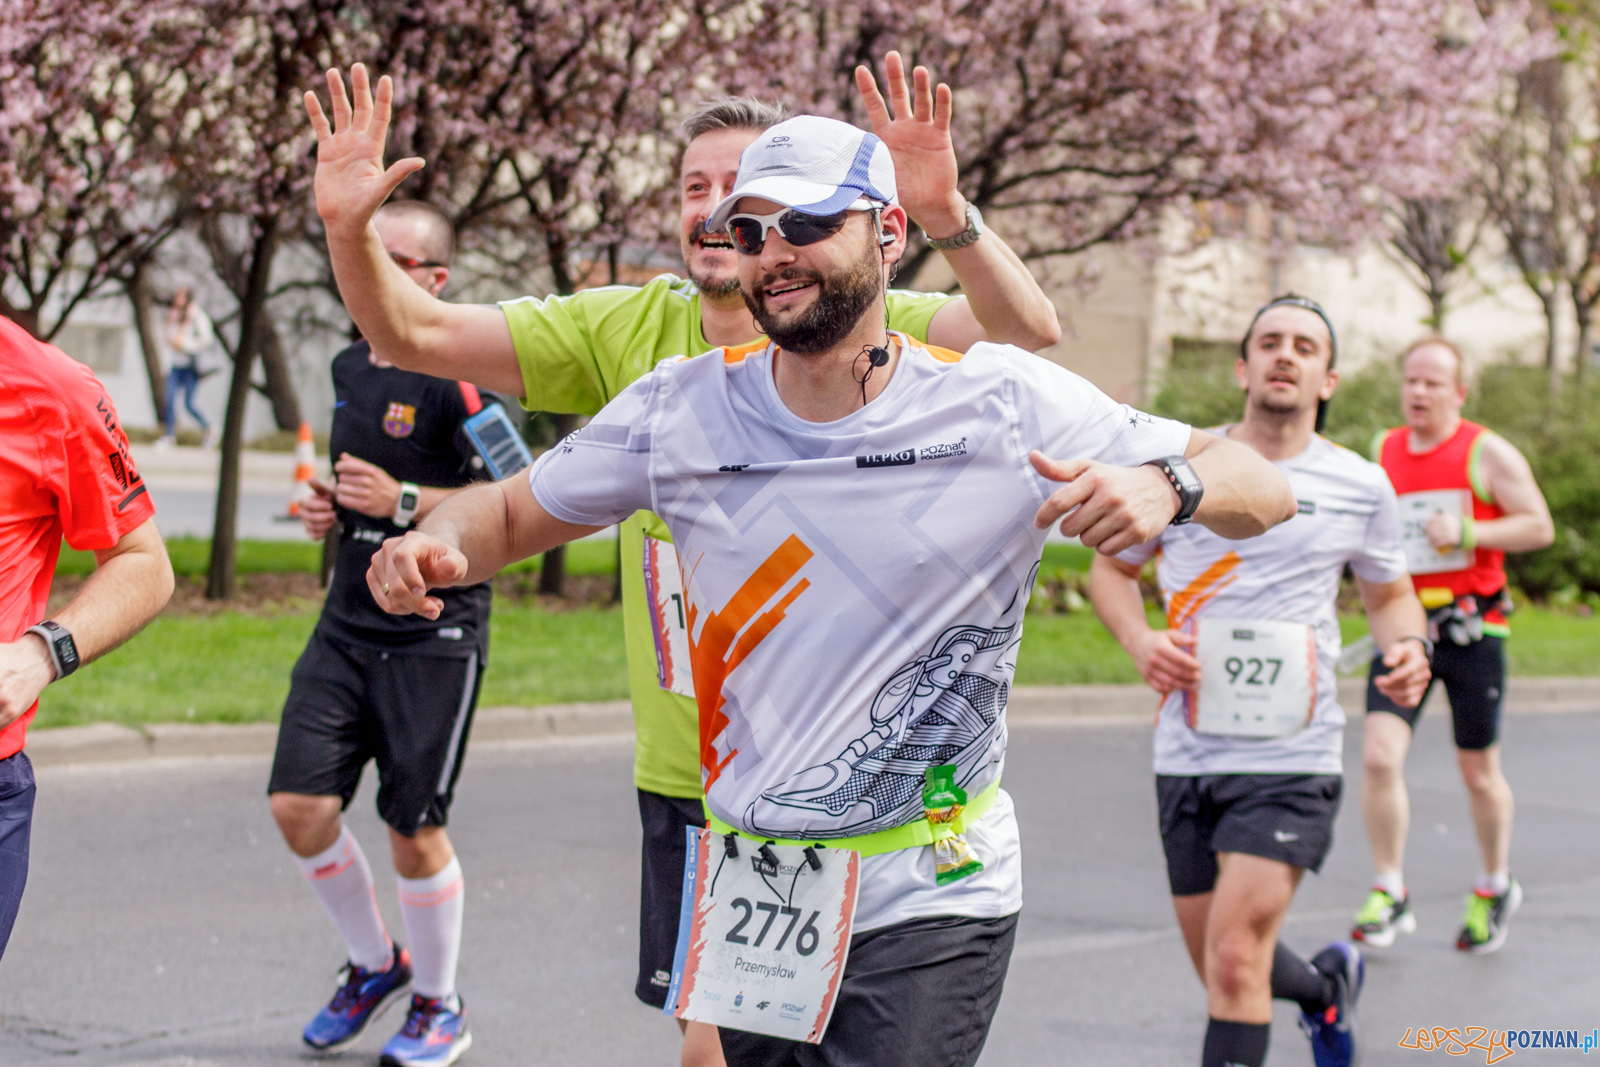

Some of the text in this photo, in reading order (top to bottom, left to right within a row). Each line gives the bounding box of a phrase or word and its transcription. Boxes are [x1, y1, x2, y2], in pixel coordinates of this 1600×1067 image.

[1224, 656, 1284, 686] 927
[725, 897, 821, 957] 2776
[734, 956, 797, 980] Przemysław
